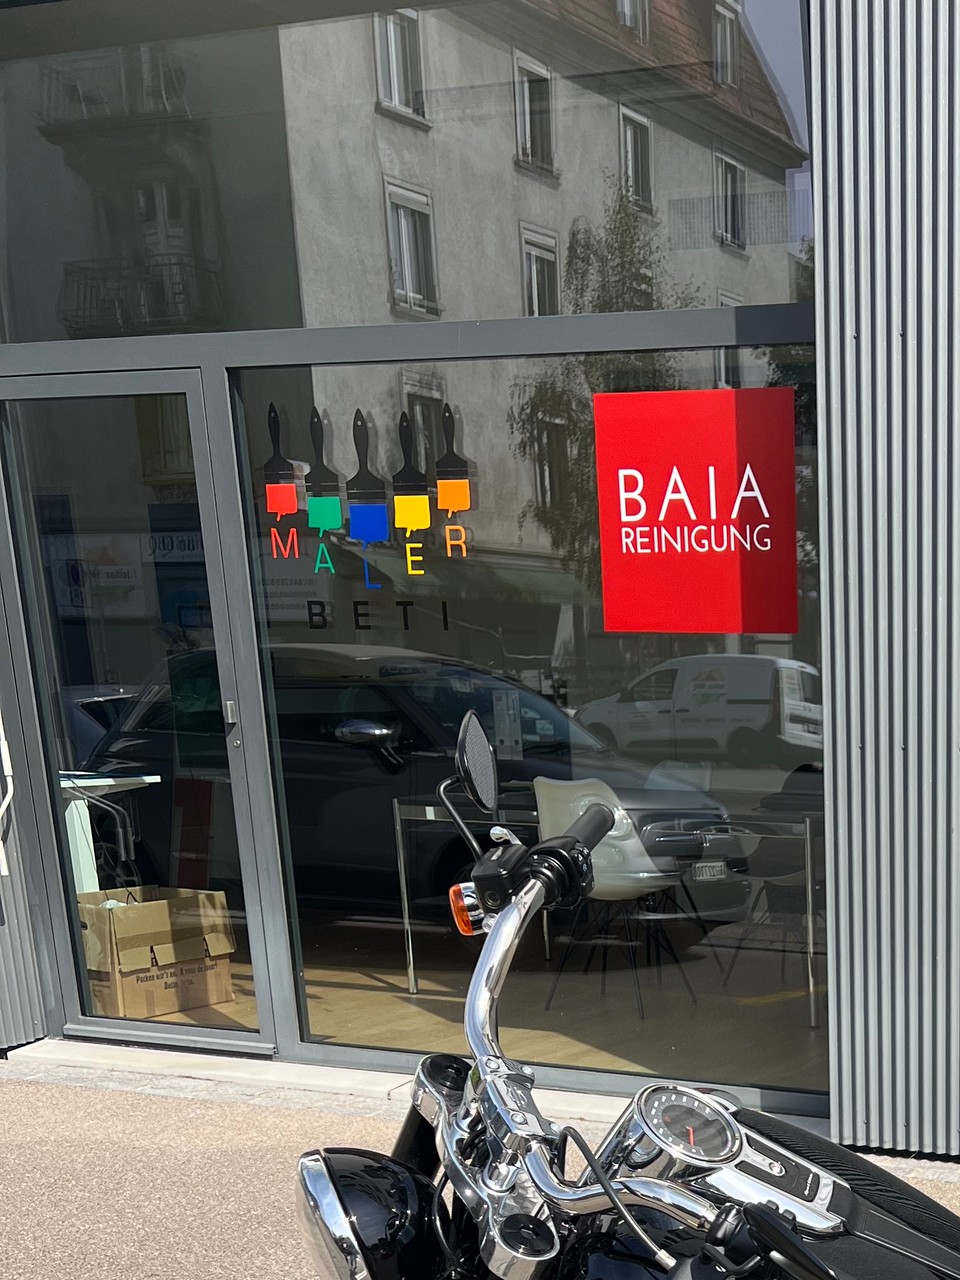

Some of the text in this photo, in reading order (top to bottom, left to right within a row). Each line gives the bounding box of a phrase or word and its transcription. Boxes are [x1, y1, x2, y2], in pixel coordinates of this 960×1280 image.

[617, 464, 769, 522] BAIA
[270, 525, 467, 590] MALER
[621, 524, 772, 554] REINIGUNG
[307, 600, 449, 631] BETI
